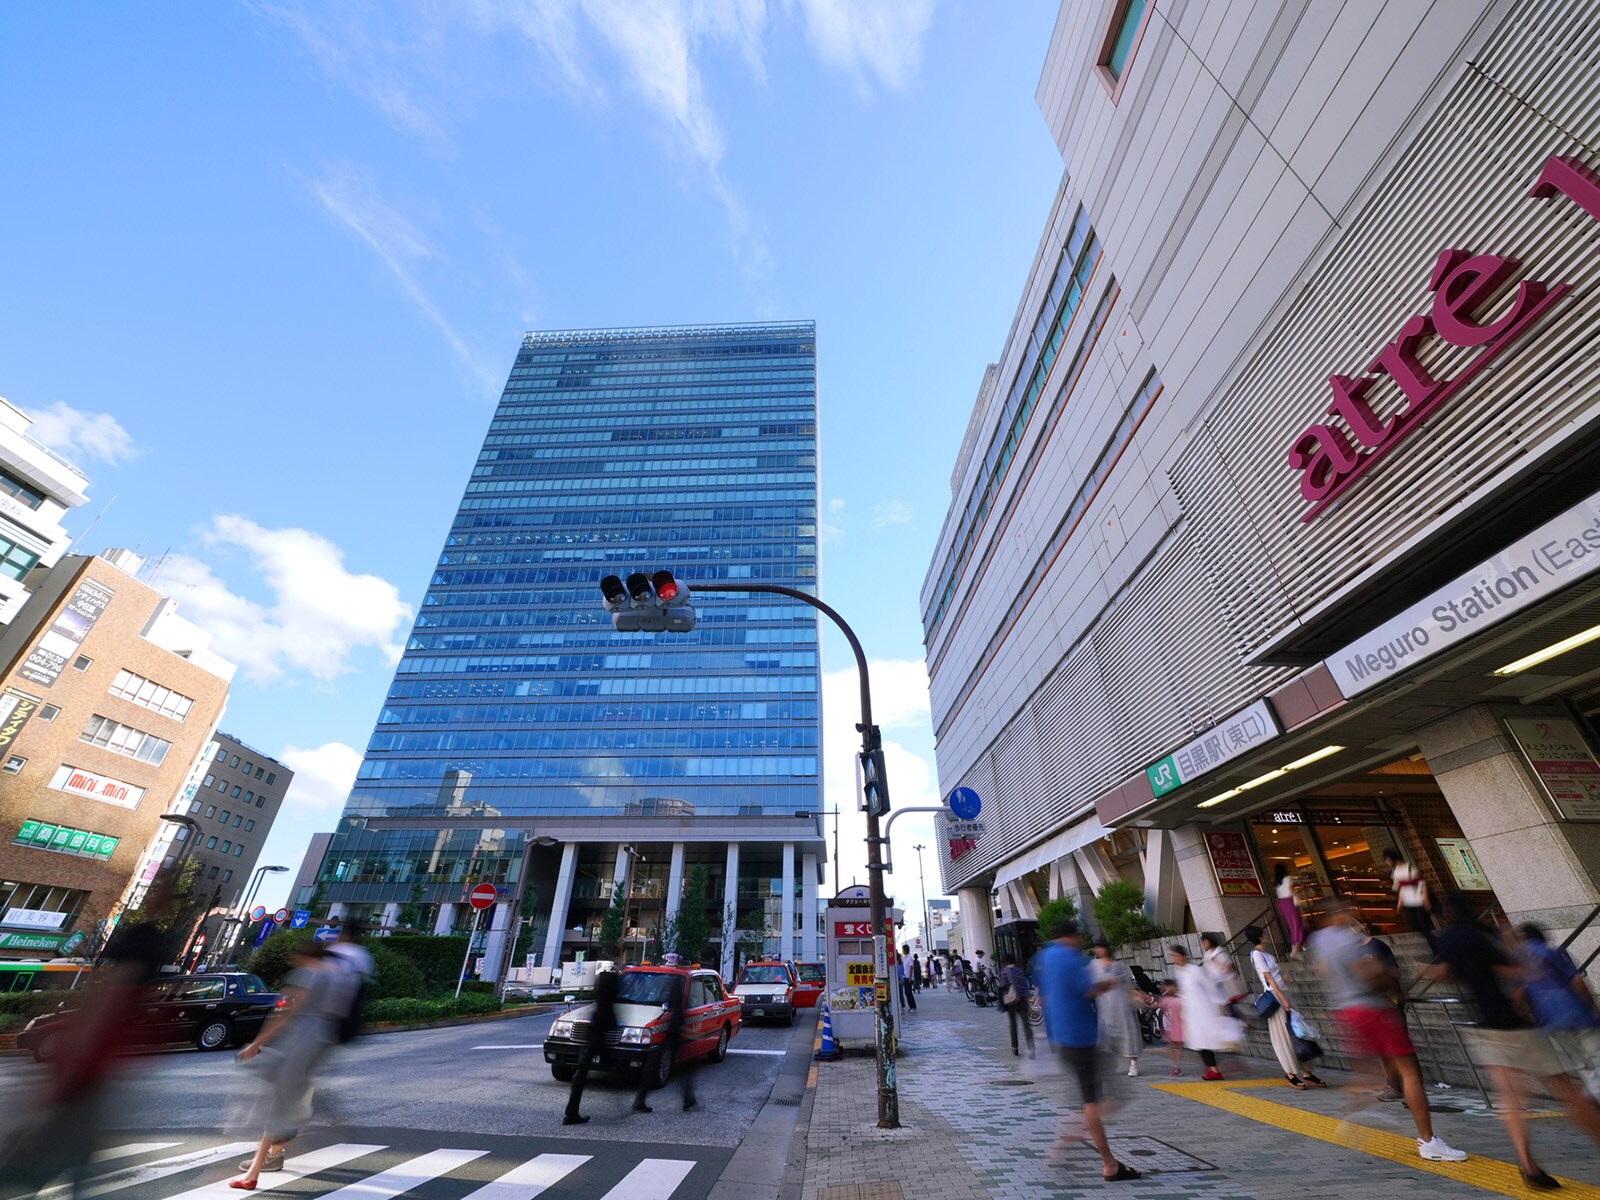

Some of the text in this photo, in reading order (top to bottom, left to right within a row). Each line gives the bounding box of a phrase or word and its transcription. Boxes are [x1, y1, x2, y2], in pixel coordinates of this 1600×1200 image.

[1288, 249, 1550, 502] atré
[1344, 626, 1431, 682] Meguro
[1432, 563, 1541, 633] Station
[45, 651, 65, 664] 0120
[1177, 710, 1268, 779] 目黒駅（東口）
[1154, 763, 1173, 786] JR
[68, 773, 130, 801] mini mini
[38, 827, 100, 850] 桑島歯科
[954, 823, 985, 832] 歩行者優先
[8, 935, 58, 948] Heineken
